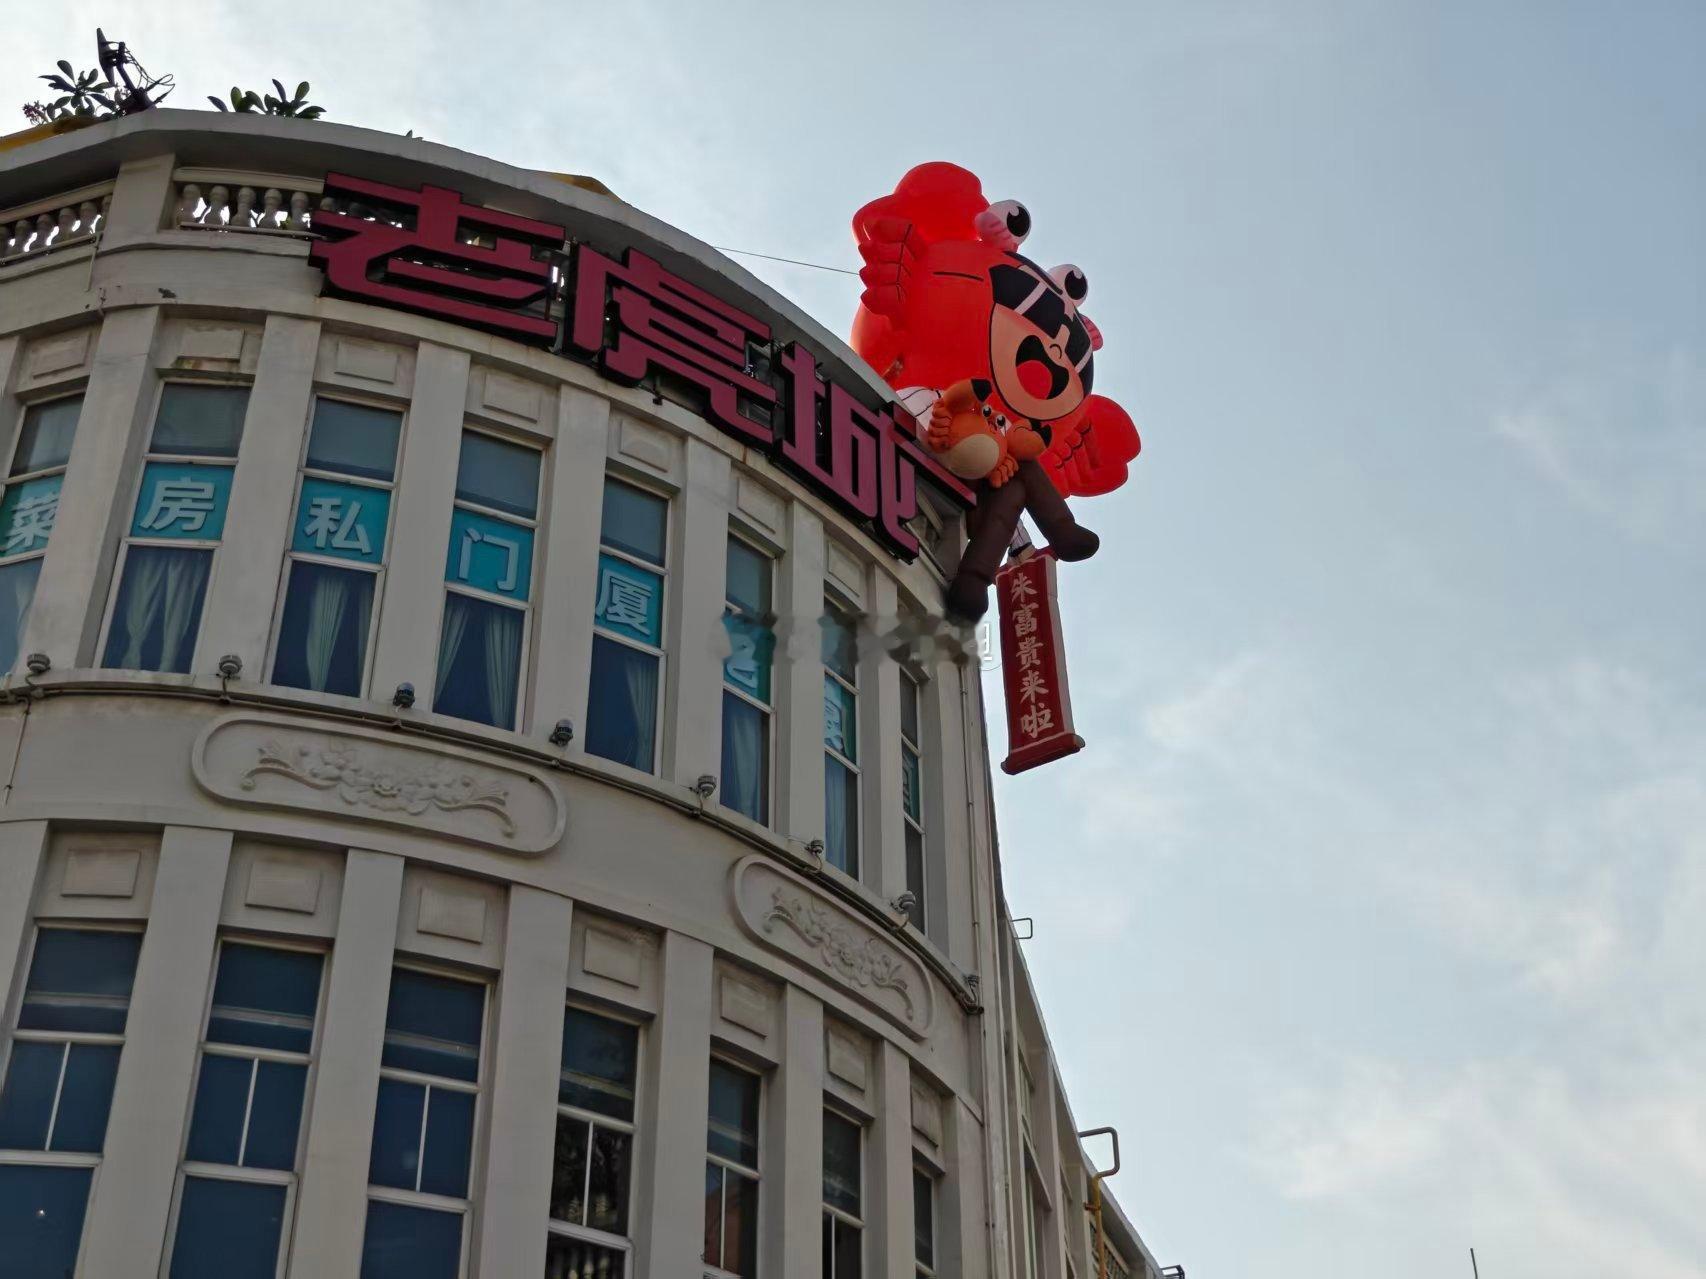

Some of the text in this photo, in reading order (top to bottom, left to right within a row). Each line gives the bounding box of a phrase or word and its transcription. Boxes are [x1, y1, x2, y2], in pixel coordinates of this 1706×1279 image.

[308, 173, 977, 562] 老虎城
[140, 477, 215, 530] 房
[305, 497, 373, 555] 私
[459, 528, 519, 591] 门
[594, 568, 652, 635] 厦
[1010, 572, 1054, 738] 朱富贵来啦
